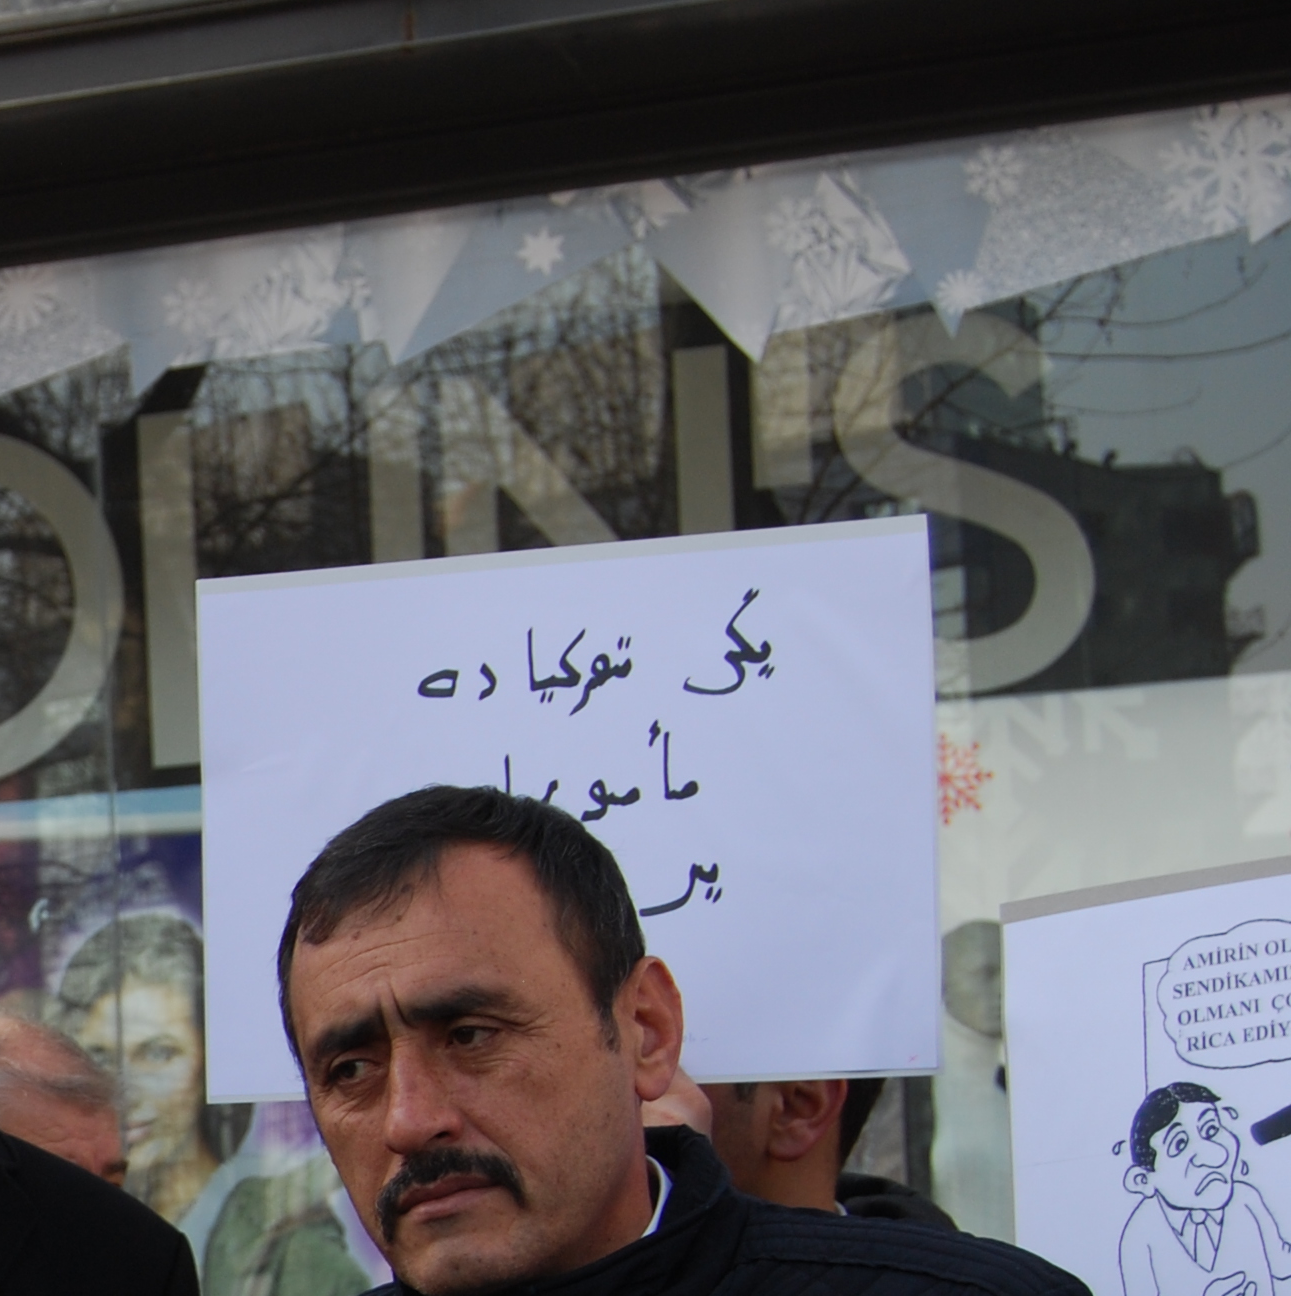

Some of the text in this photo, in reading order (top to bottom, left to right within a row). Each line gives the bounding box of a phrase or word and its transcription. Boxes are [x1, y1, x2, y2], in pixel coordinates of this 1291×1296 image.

[1183, 942, 1259, 971] AMİRİN
[1172, 964, 1291, 1000] SENDİKAMI
[1177, 998, 1260, 1026] OLMANI
[1186, 1031, 1236, 1052] RİCA
